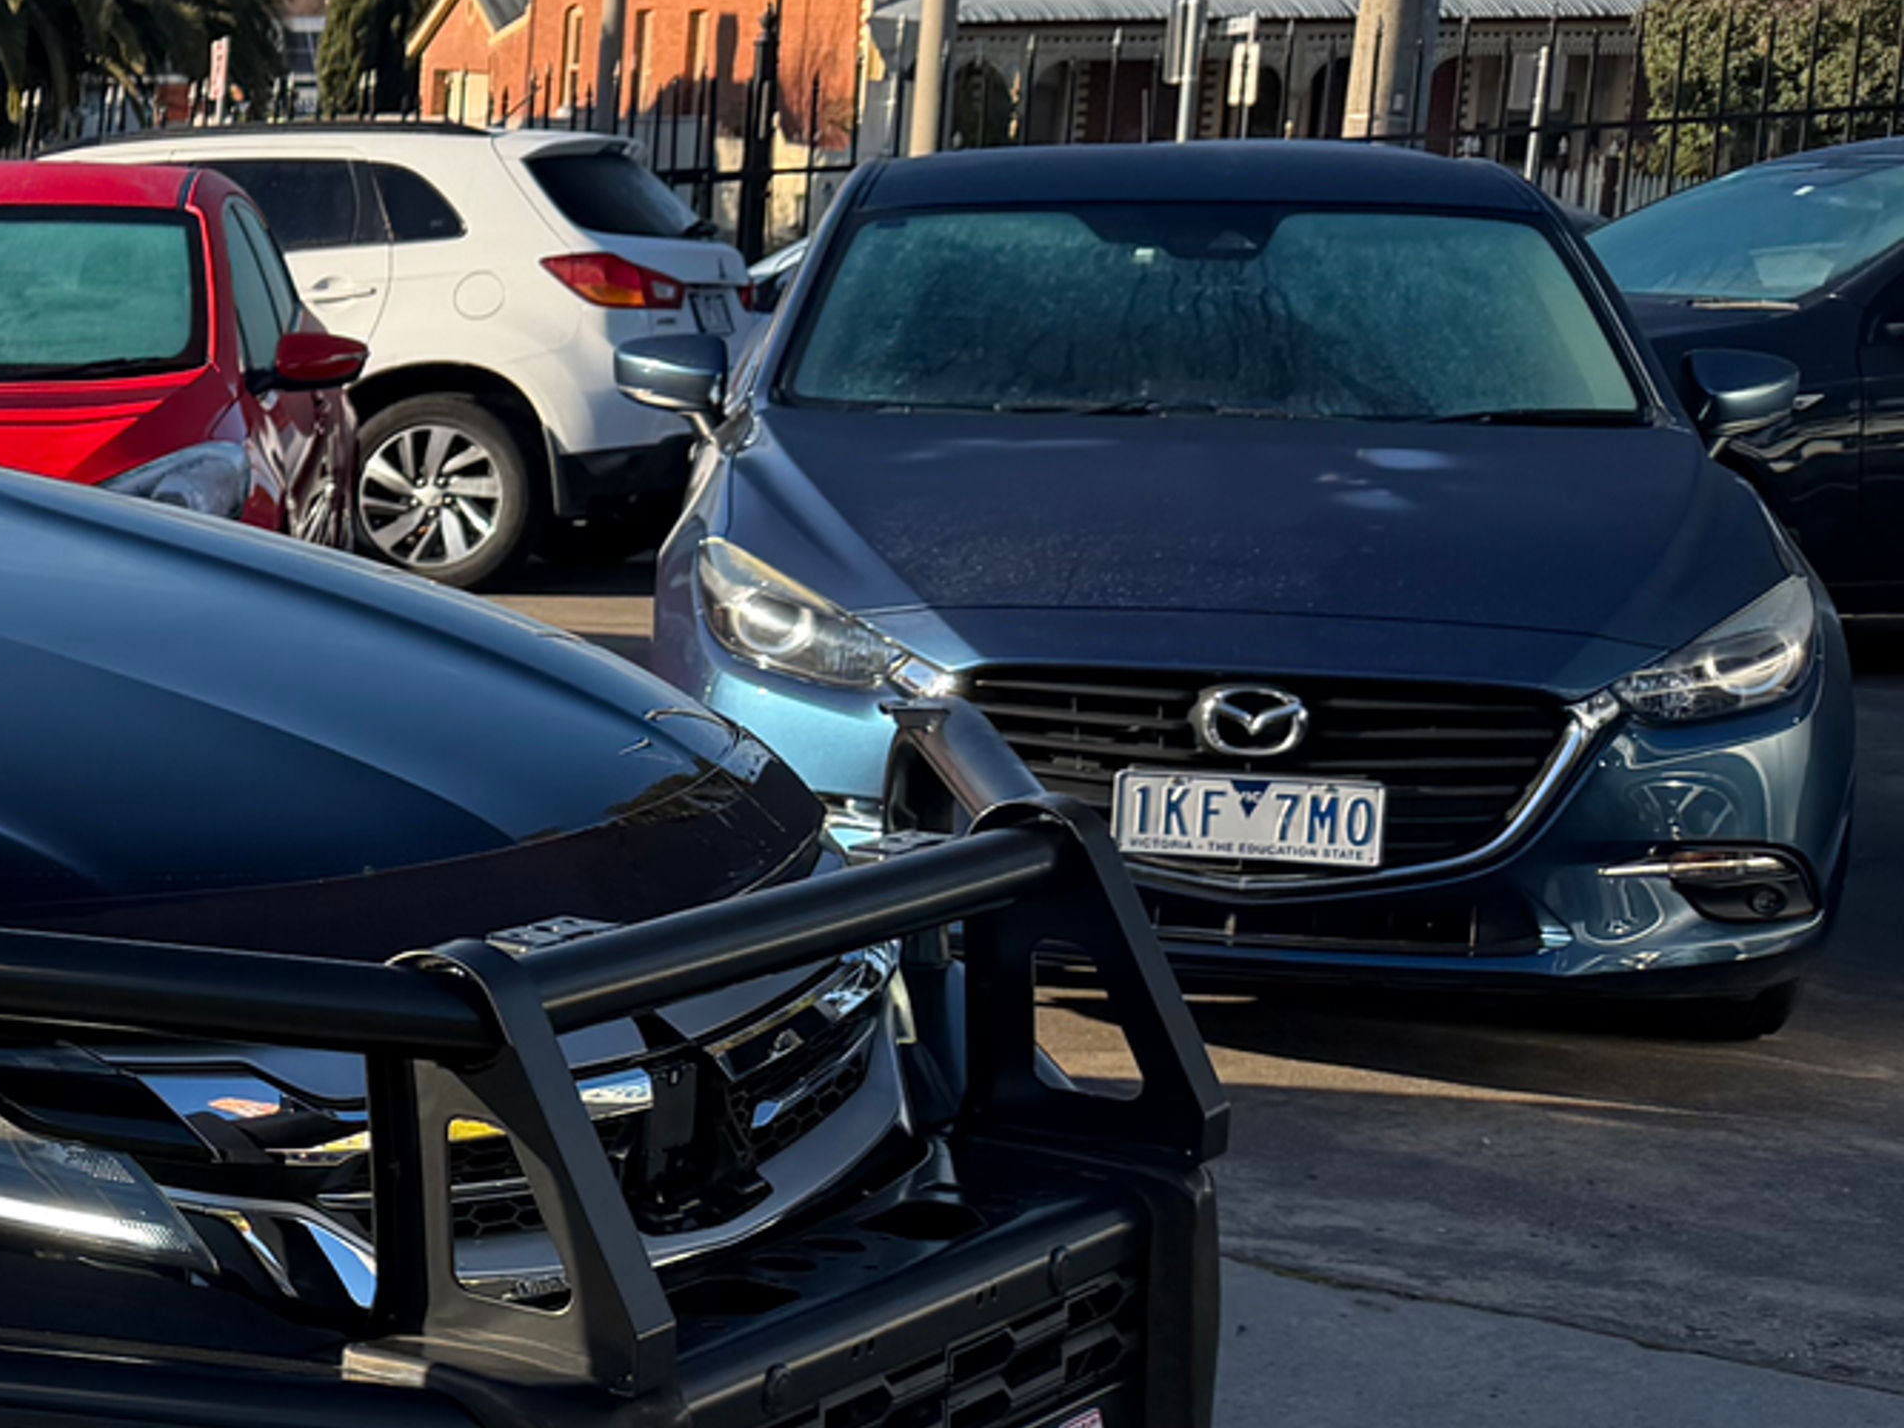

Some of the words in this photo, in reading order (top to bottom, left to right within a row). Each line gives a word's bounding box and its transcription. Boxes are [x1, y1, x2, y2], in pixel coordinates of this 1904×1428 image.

[1133, 783, 1227, 837] 1KF
[1129, 837, 1192, 851] VICTORIA
[1207, 841, 1234, 853] THE
[1238, 843, 1318, 858] EDUCATION
[1322, 848, 1364, 861] STATE
